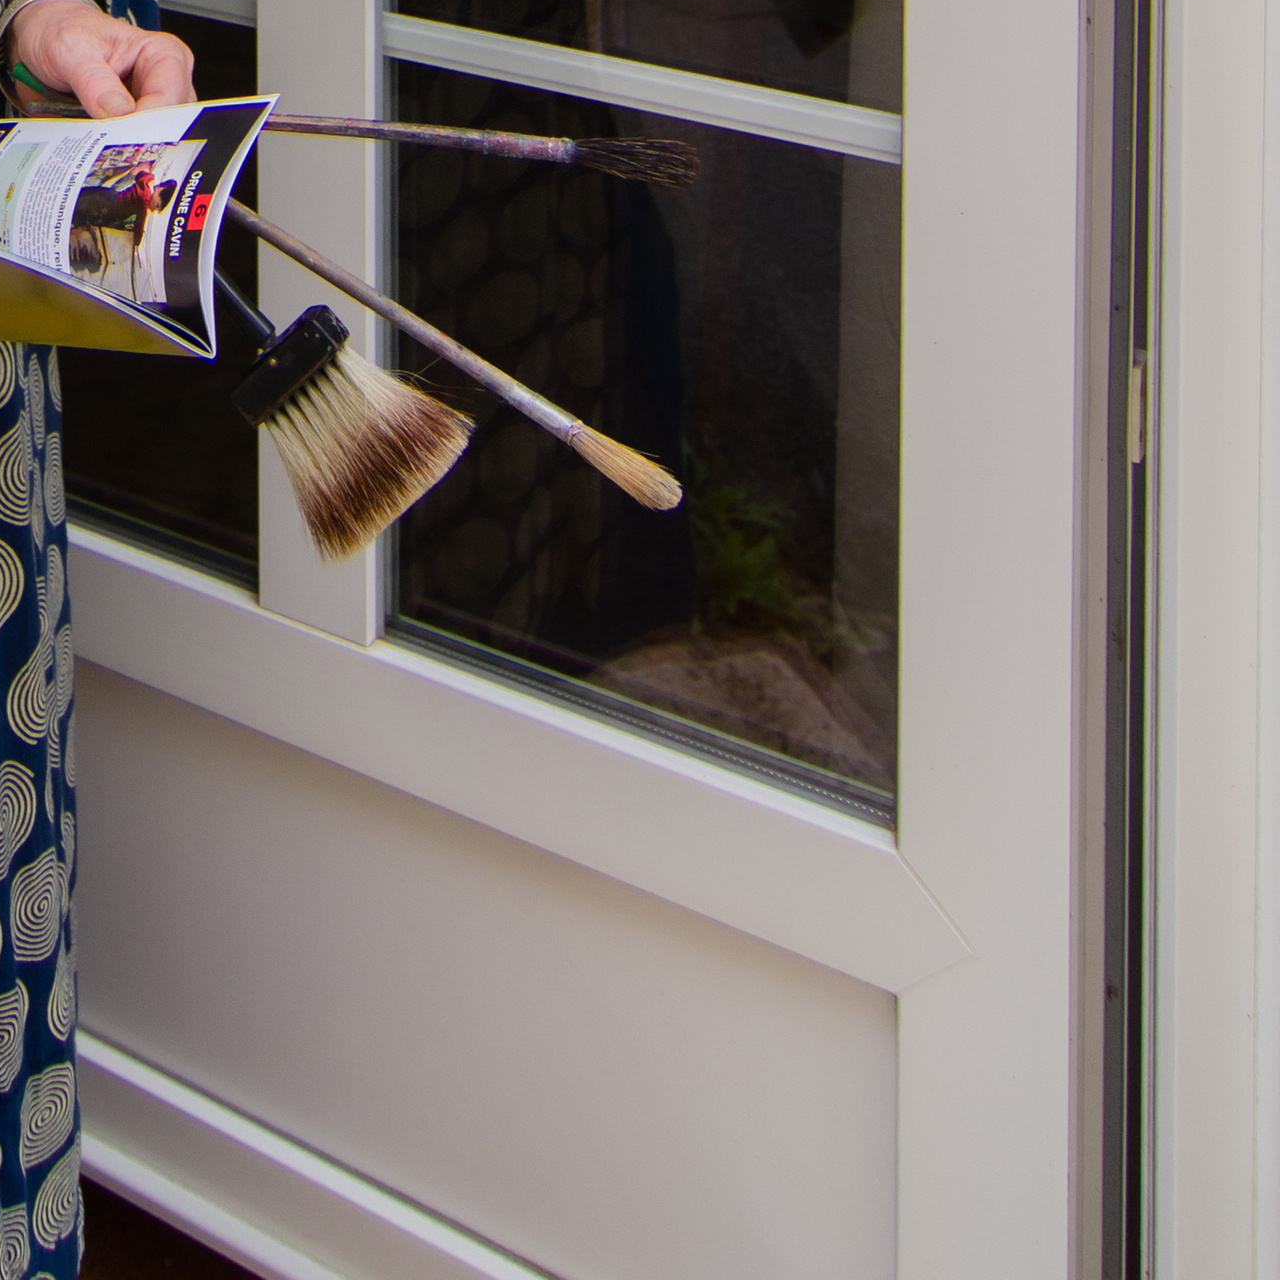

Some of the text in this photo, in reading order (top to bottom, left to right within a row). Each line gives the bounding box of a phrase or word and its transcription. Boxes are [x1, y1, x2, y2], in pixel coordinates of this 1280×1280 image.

[168, 170, 203, 257] ORIANE CAVIN
[194, 203, 207, 218] 6
